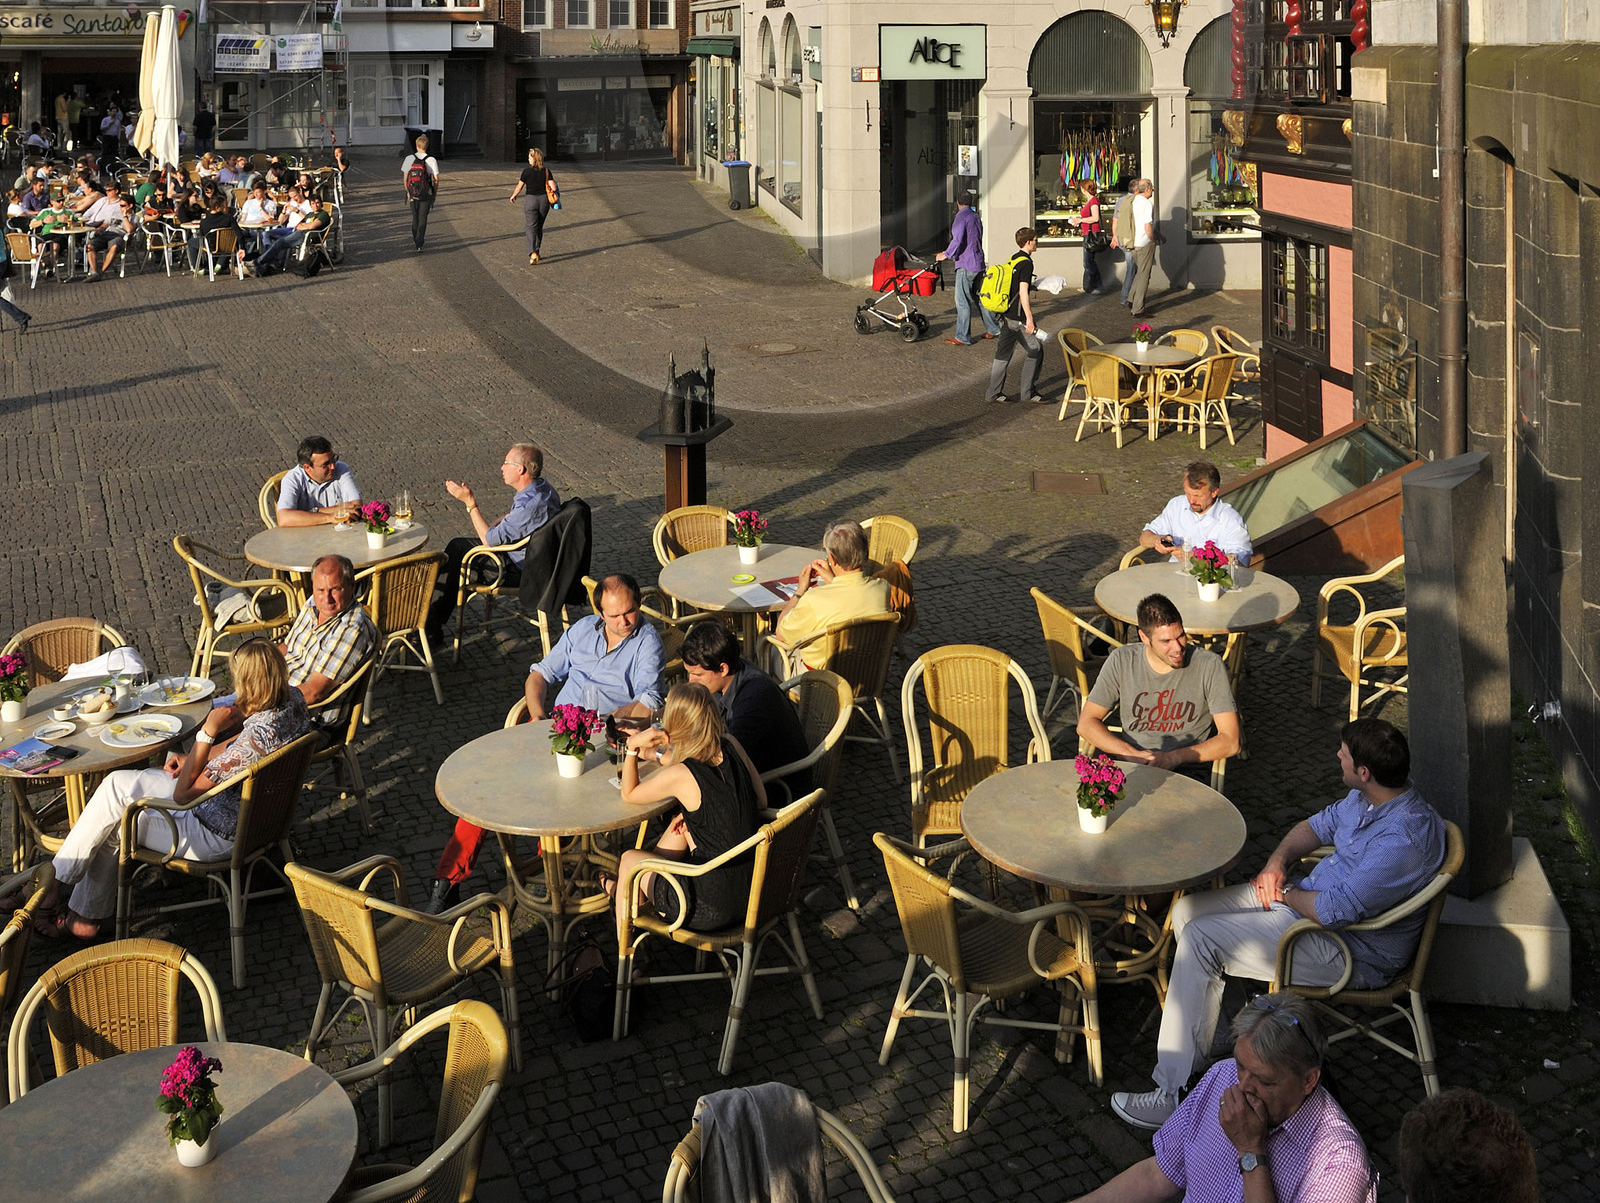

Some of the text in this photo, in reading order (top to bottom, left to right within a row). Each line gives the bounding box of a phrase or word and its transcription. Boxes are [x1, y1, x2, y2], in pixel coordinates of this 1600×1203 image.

[63, 13, 148, 35] Santaro
[1128, 689, 1198, 731] G-Star
[1138, 722, 1185, 733] DENIM
